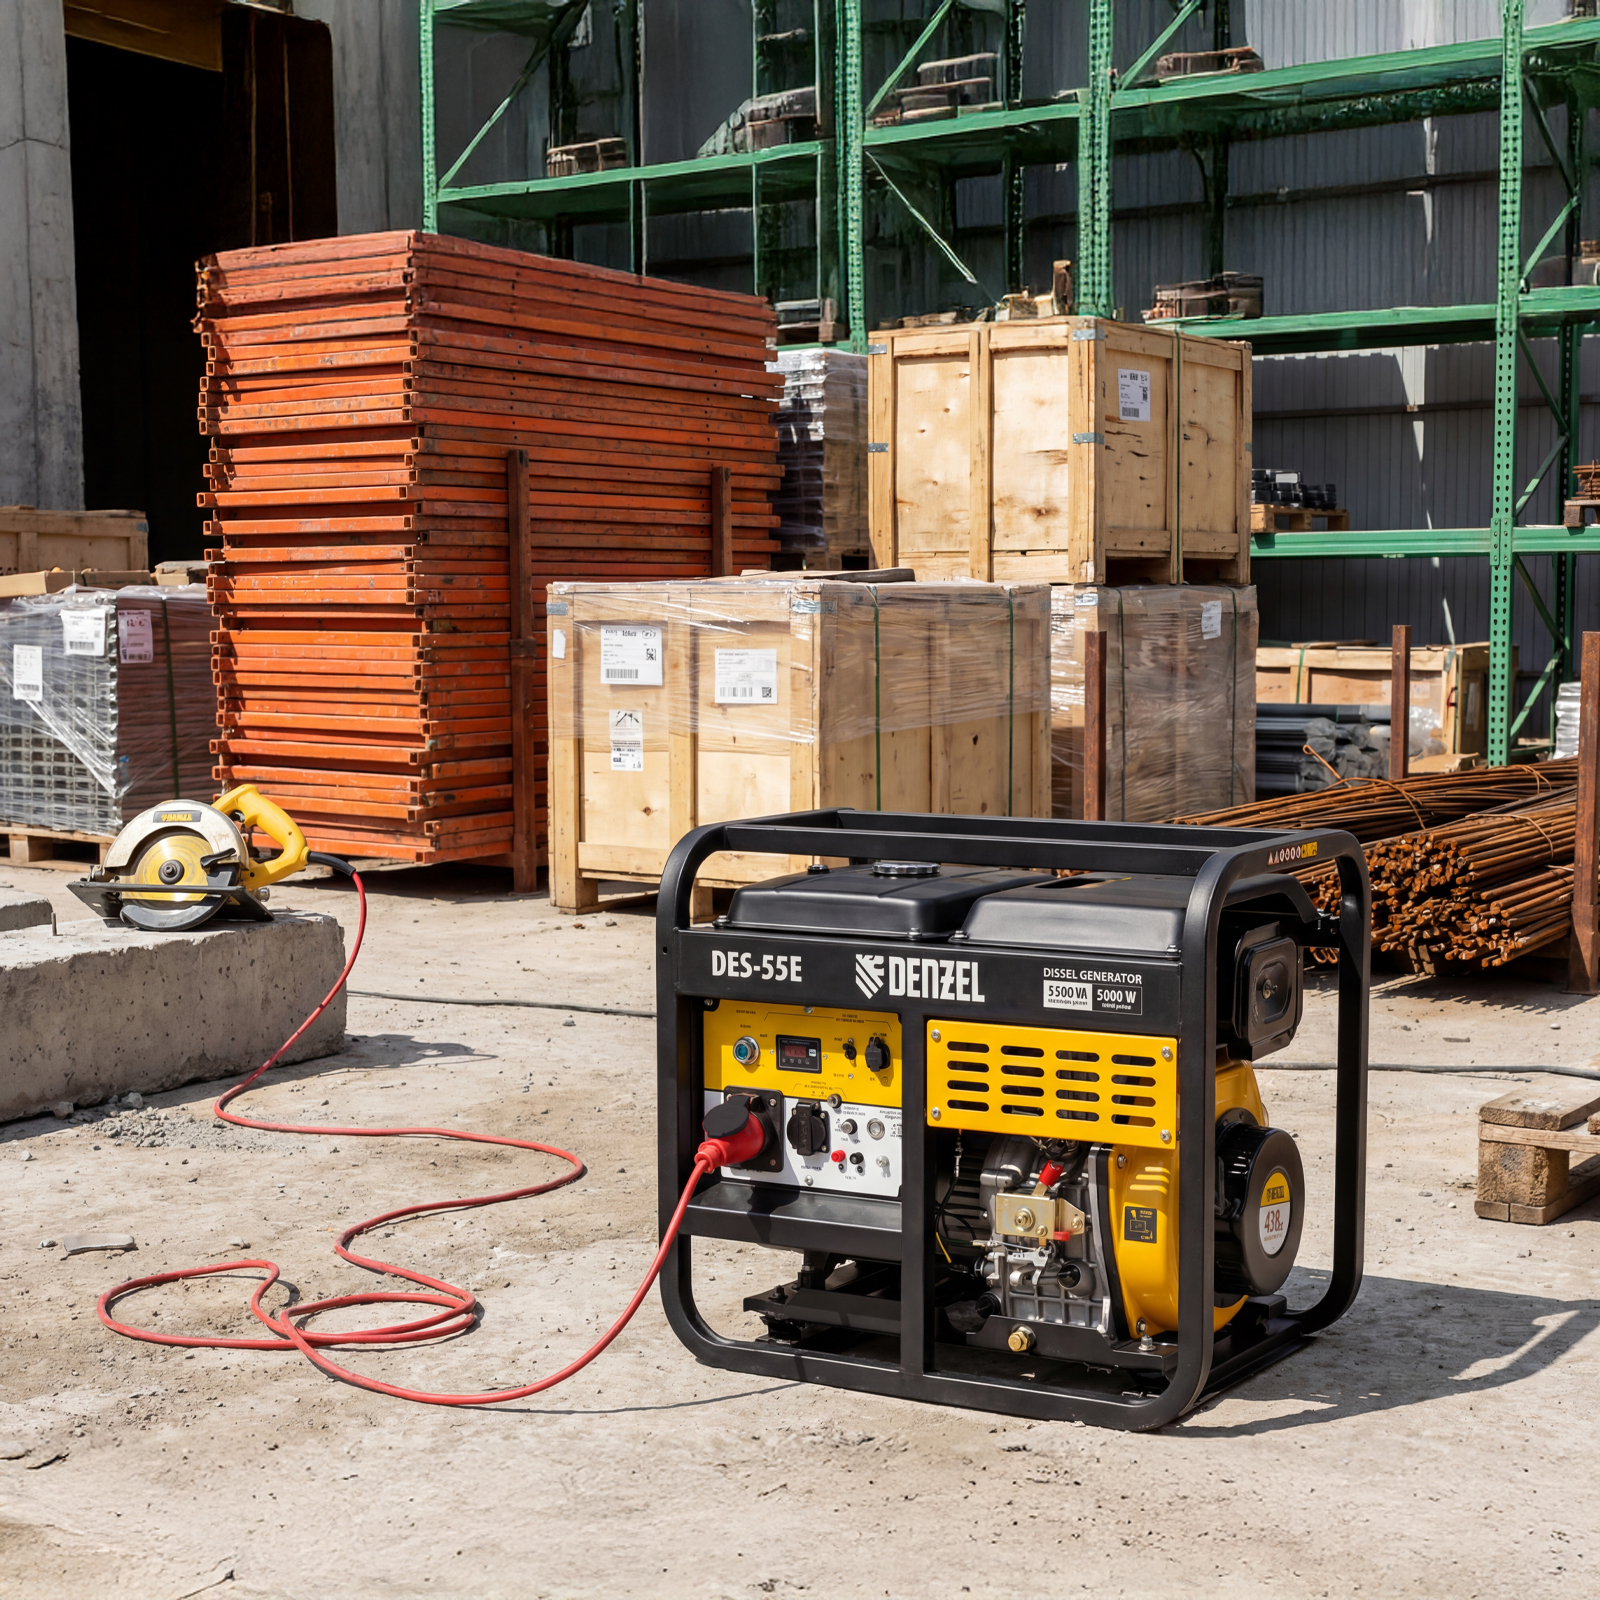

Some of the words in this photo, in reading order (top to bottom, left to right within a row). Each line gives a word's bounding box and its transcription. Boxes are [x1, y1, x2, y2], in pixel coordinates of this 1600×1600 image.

[711, 949, 802, 982] DES-55E
[889, 956, 985, 1003] DENZEL
[1043, 967, 1078, 980] DISSEL
[1079, 970, 1142, 984] GENERATOR
[1048, 985, 1074, 998] 5500
[1075, 986, 1088, 999] VA
[1096, 989, 1123, 1003] 5000
[1124, 990, 1137, 1004] W
